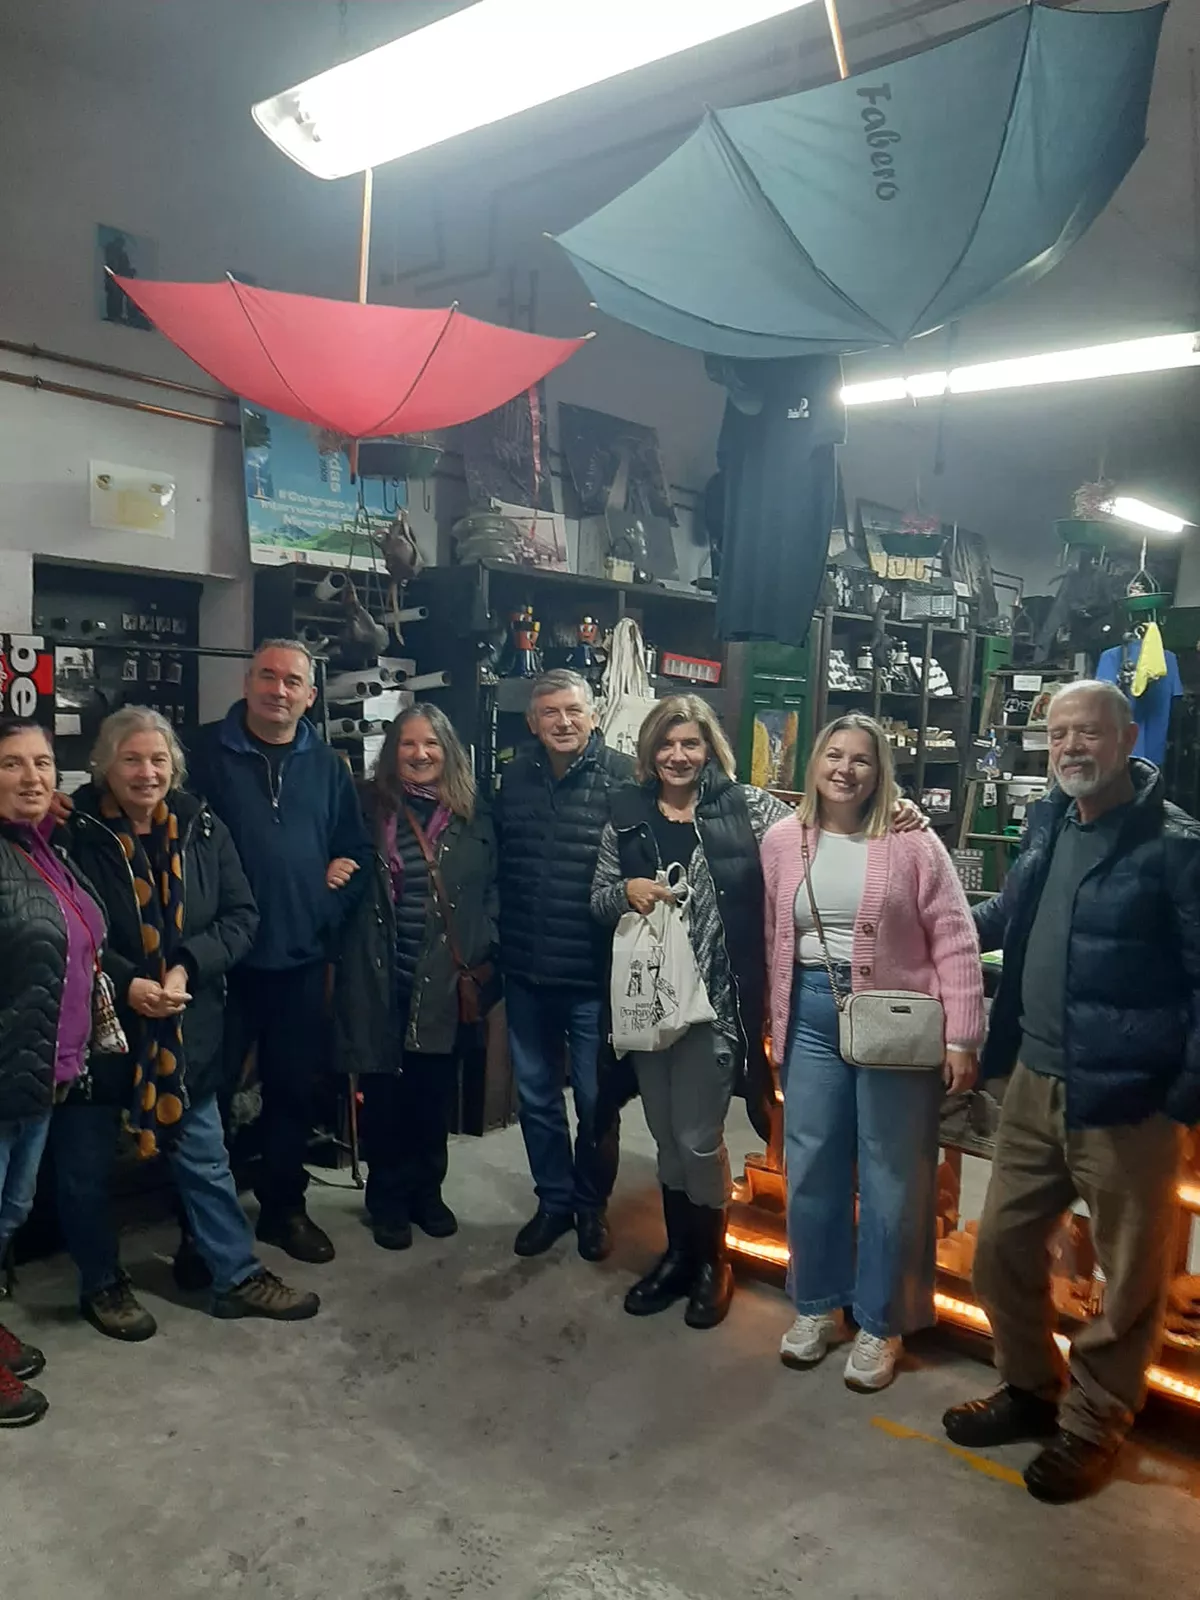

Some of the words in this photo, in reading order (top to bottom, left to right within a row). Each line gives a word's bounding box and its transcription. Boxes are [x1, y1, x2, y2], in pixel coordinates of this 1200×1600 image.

[856, 82, 902, 202] Fabero
[288, 490, 346, 510] Congreso
[261, 500, 341, 521] Internacional
[283, 513, 327, 530] Minero
[328, 523, 341, 533] de
